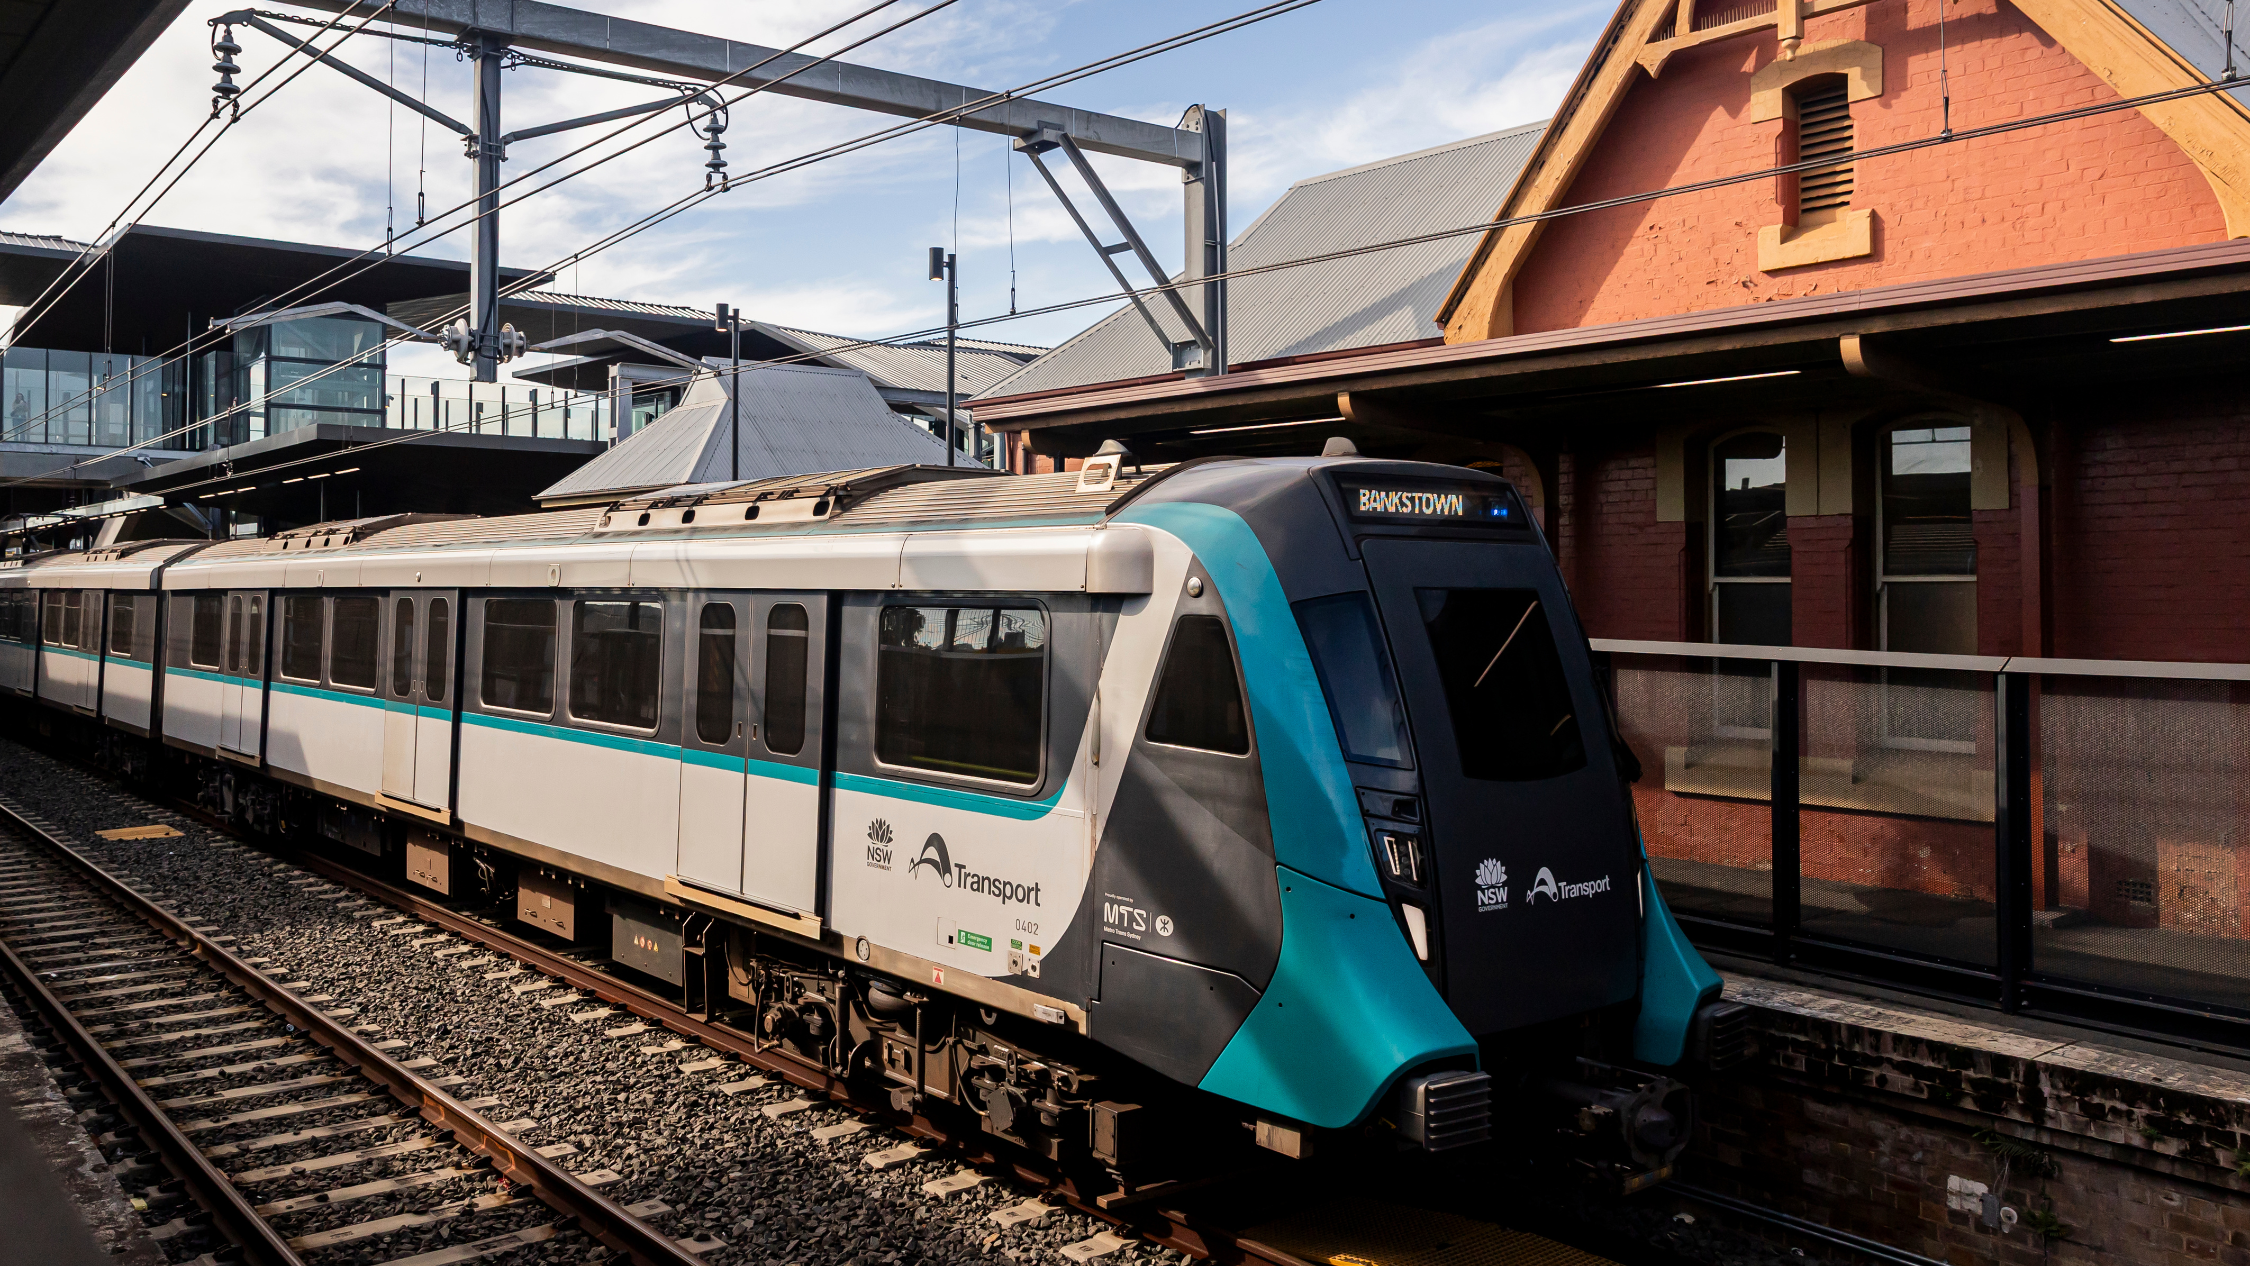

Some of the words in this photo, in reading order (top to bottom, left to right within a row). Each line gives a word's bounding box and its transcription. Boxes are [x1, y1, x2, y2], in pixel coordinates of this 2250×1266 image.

[1359, 489, 1463, 516] BANKSTOWN
[867, 845, 893, 865] NSW
[866, 862, 892, 871] GOVERNMENT
[954, 862, 1041, 907] Transport
[1558, 875, 1611, 899] Transport
[1477, 887, 1508, 906] NSW
[1103, 901, 1147, 931] MTS
[1478, 903, 1508, 913] GOVERNMENT
[1015, 918, 1039, 936] 0402
[1126, 931, 1142, 941] Sydney
[967, 933, 988, 945] Emergency
